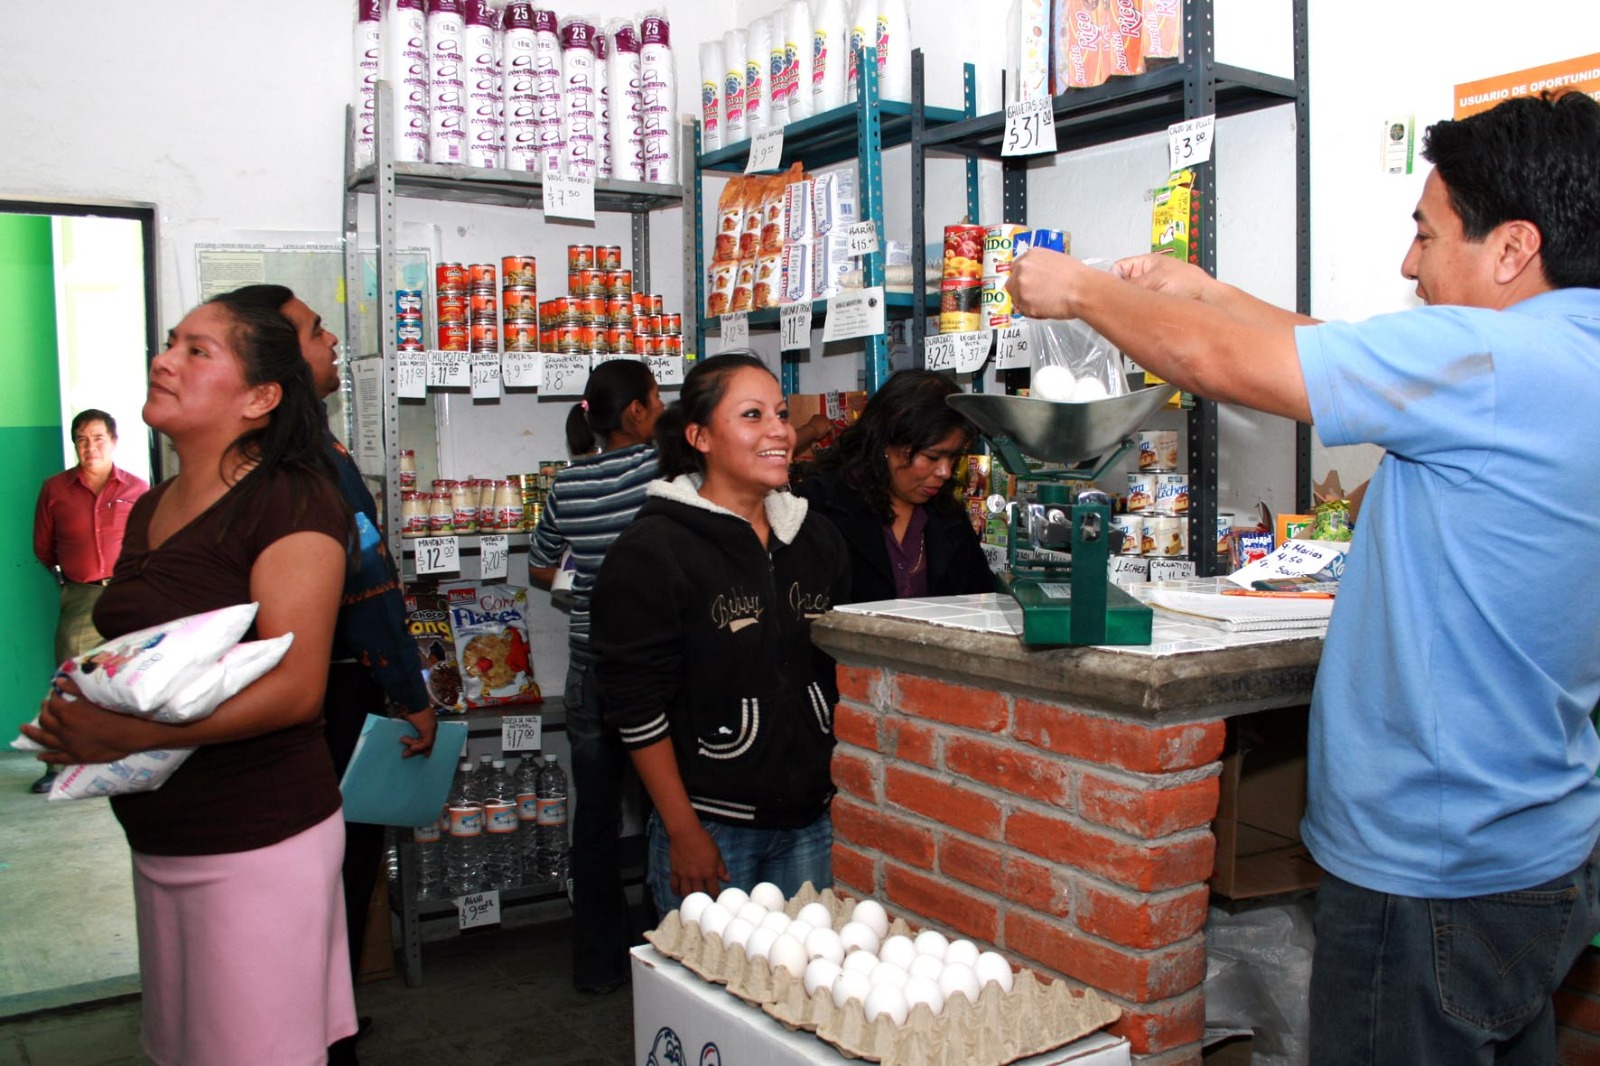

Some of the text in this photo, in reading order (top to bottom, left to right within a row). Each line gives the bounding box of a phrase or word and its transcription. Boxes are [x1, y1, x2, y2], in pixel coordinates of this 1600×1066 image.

[513, 7, 529, 20] 25
[536, 11, 549, 22] 25
[571, 27, 586, 39] 25
[645, 23, 659, 35] 25
[1460, 68, 1600, 107] USUARIO DE OPORTUNID
[1007, 100, 1037, 119] GALLETAS
[982, 291, 1005, 303] IDO
[1002, 328, 1020, 339] LALA
[1241, 535, 1273, 545] Kool-Aid
[412, 610, 444, 619] choco
[406, 620, 454, 643] ong
